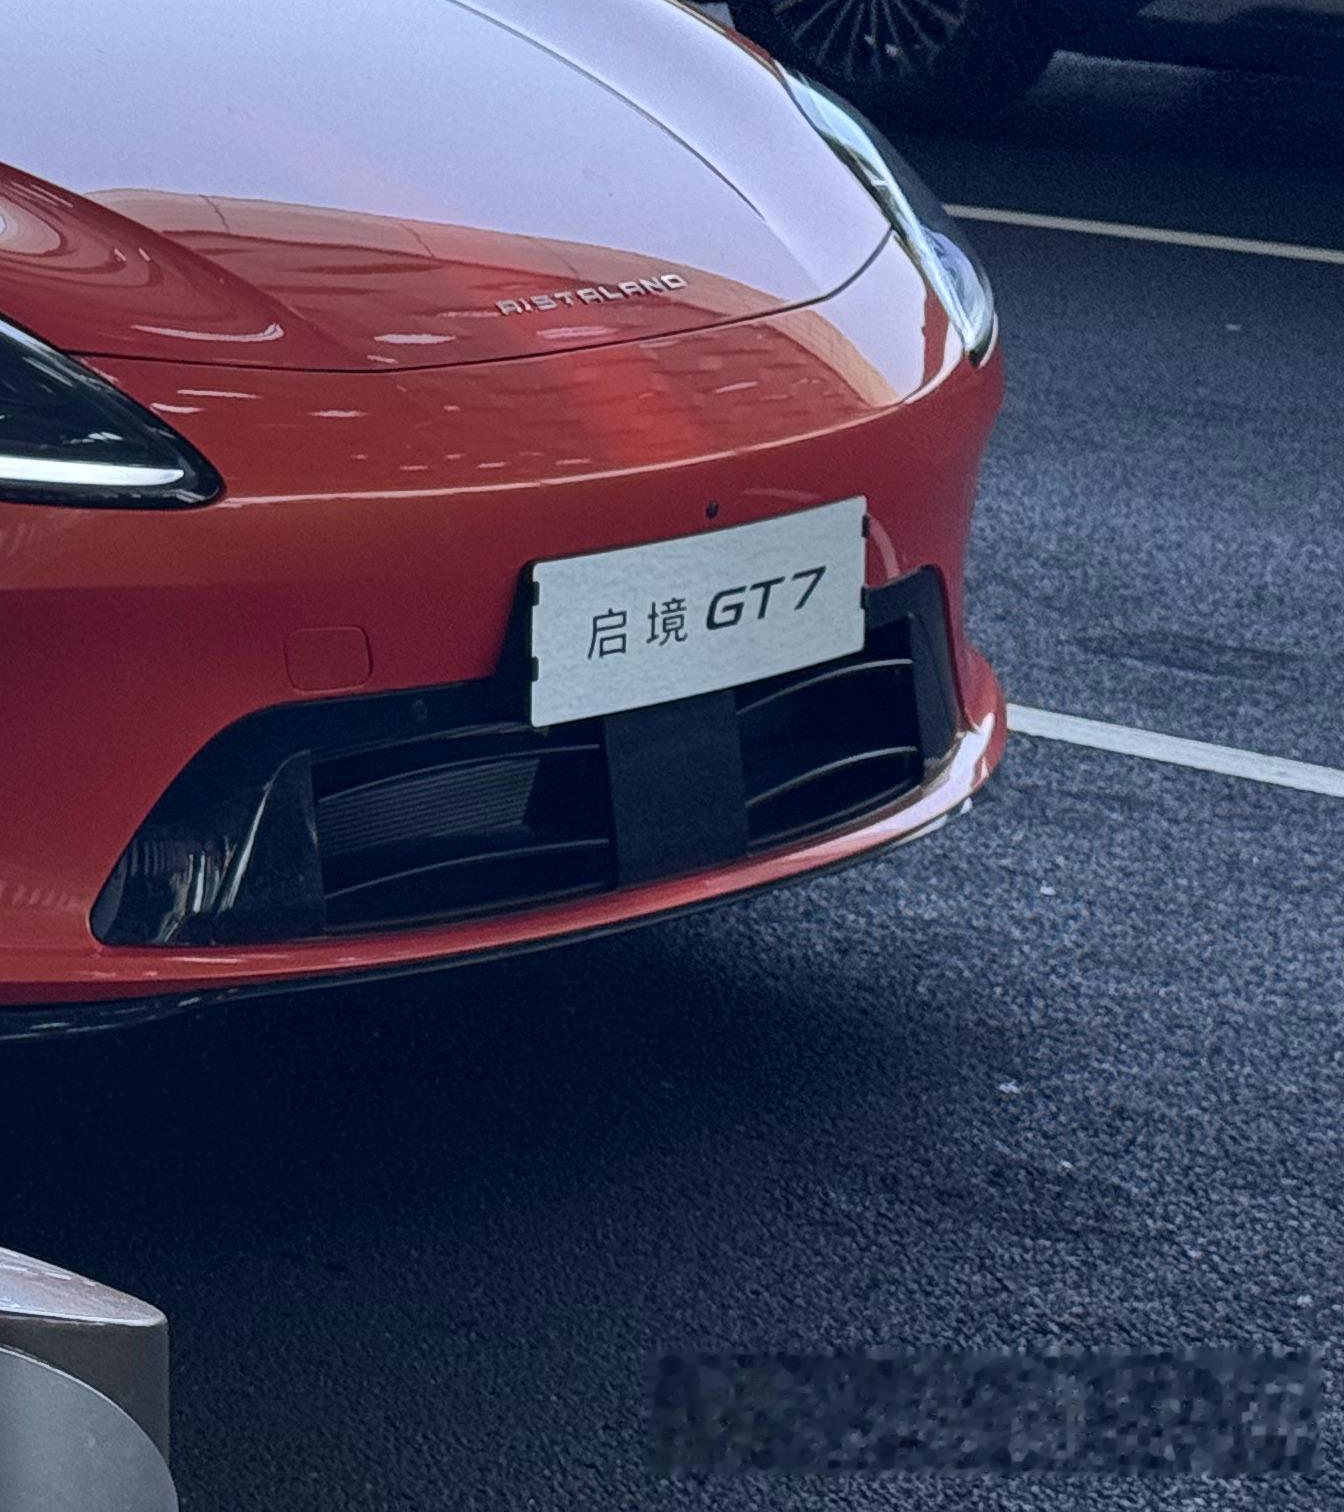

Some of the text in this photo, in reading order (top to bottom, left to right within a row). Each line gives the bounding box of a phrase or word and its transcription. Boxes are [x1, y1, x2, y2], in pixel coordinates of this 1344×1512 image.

[495, 272, 688, 316] AISTALAND
[587, 566, 827, 661] 启境 GT7
